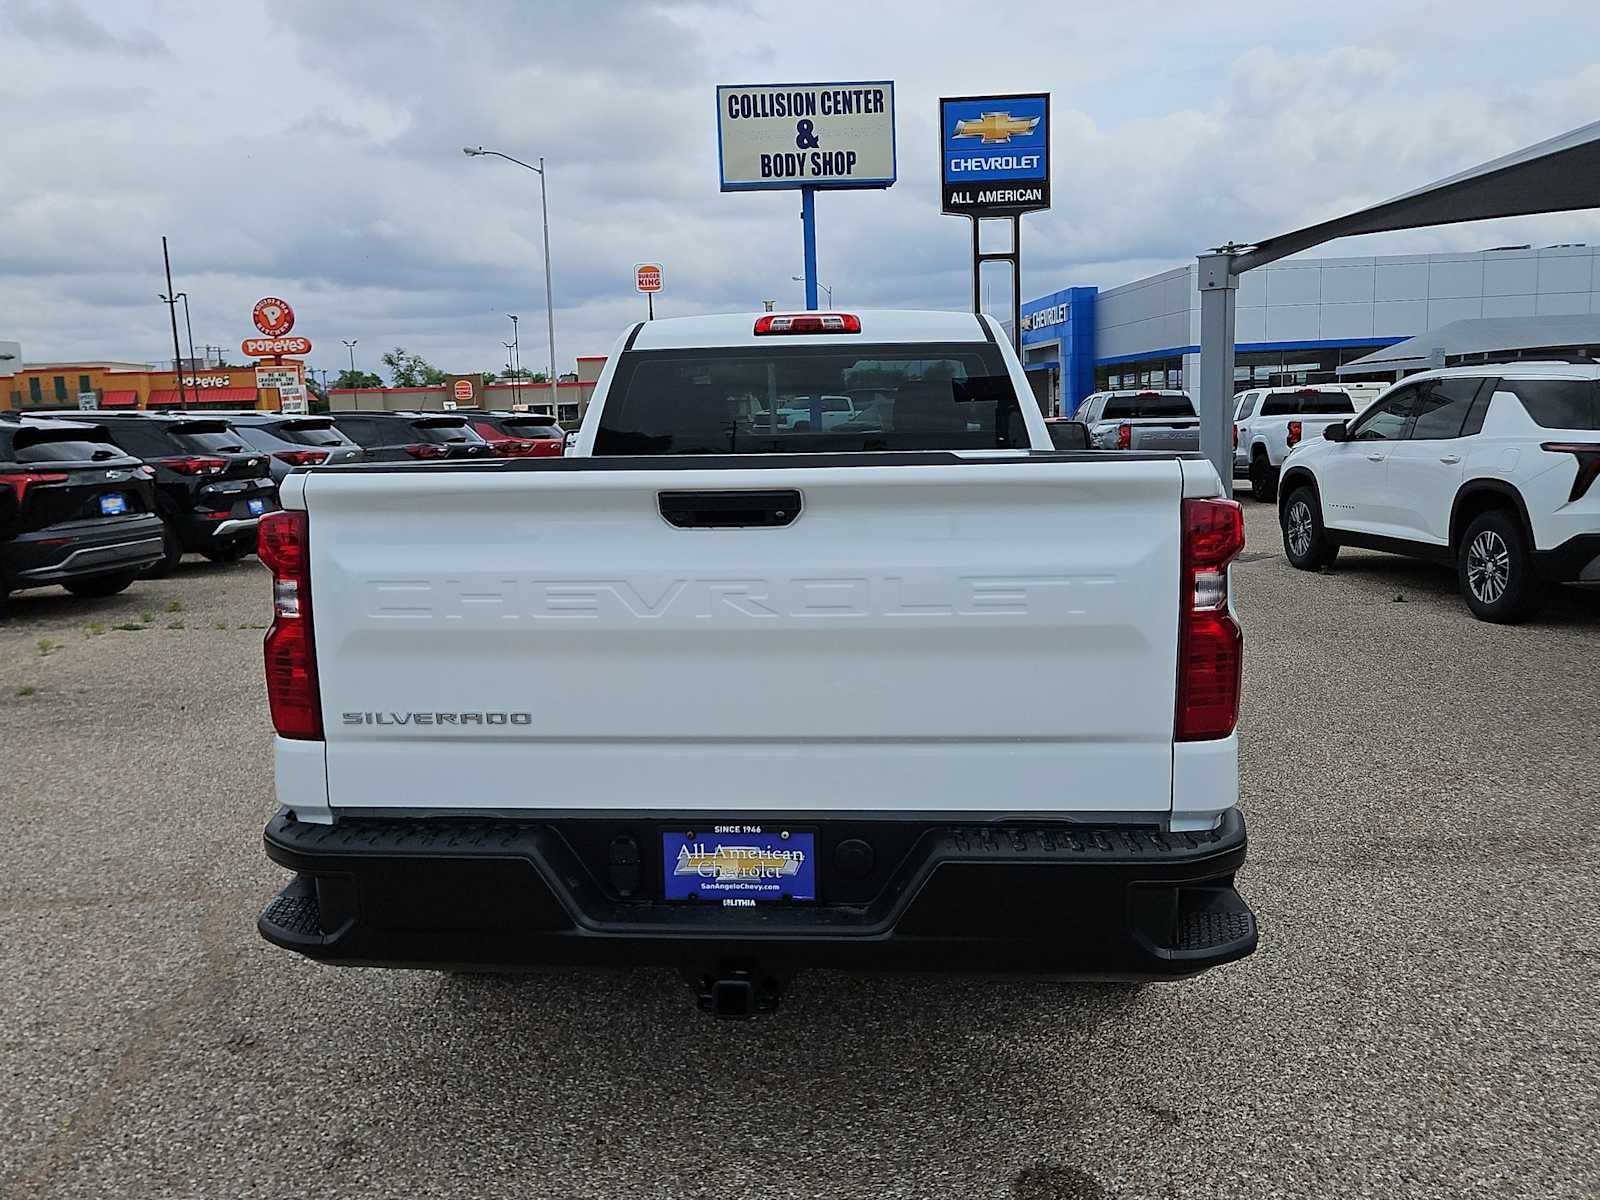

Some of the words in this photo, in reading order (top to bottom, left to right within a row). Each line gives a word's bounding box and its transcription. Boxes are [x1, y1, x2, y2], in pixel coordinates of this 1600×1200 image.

[728, 92, 816, 119] COLLISION
[820, 89, 884, 116] CENTER
[796, 119, 819, 150] &
[761, 153, 806, 178] BODY
[810, 151, 856, 176] SHOP
[951, 155, 1040, 172] CHEVROLET
[951, 191, 974, 204] ALL
[977, 189, 1042, 203] AMERICAN
[254, 298, 289, 315] LOUISIANA
[262, 306, 281, 326] P
[1032, 303, 1069, 330] CHEVROLET
[257, 321, 289, 336] KITCHEN
[367, 574, 1116, 619] CHEVROLET
[342, 711, 532, 725] SILVERADO
[714, 825, 740, 833] SINCE
[743, 825, 761, 833] 1946
[677, 843, 705, 859] All
[713, 844, 805, 861] American
[697, 861, 783, 879] Chevrolet
[701, 883, 780, 891] SanAngeloChevy.com
